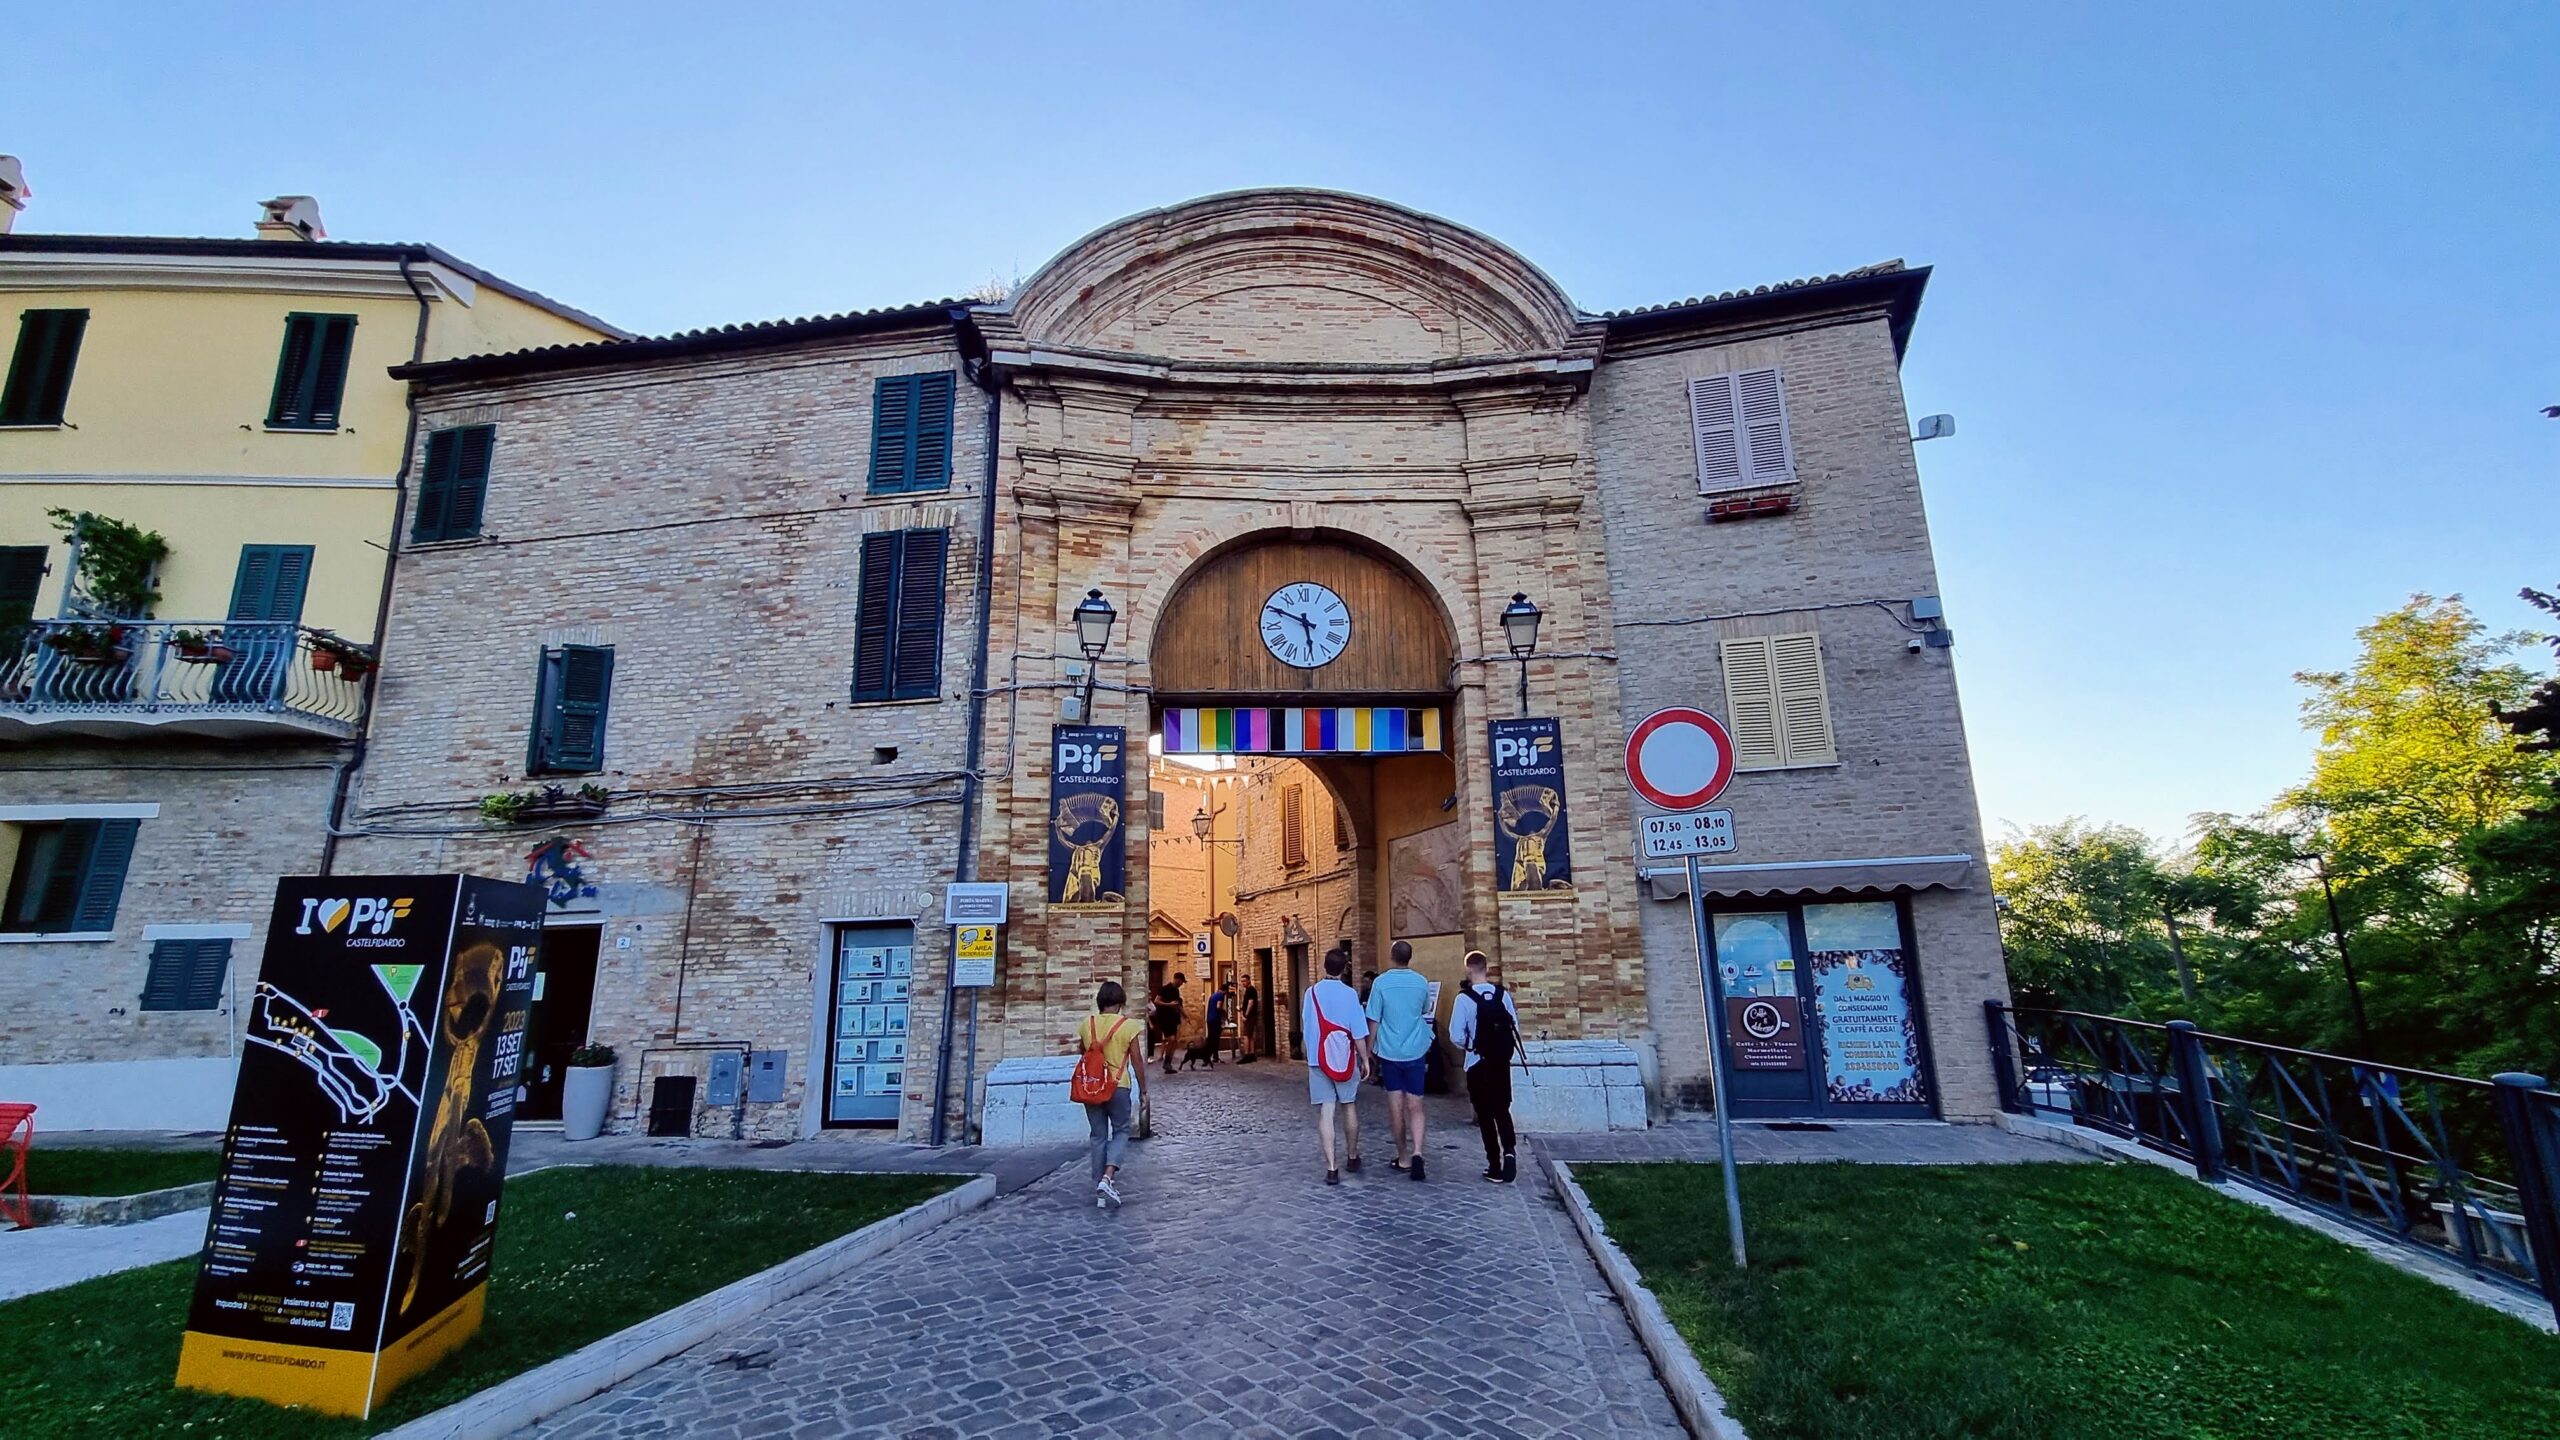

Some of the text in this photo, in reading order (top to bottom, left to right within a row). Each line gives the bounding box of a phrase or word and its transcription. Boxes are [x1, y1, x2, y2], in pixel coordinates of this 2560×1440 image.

[1297, 588, 1309, 602] XII
[1320, 643, 1331, 657] V
[1497, 767, 1556, 777] CASTELFIDARDO
[1058, 775, 1119, 784] CASTELFIDARDO
[296, 898, 318, 934] I
[346, 939, 405, 947] CASTELFIDARDO
[502, 1010, 526, 1032] 2023
[1832, 1015, 1899, 1023] GRATUITAMENTE
[1845, 1025, 1867, 1033] CAFFÈ
[496, 1032, 523, 1056] 13 SET
[492, 1054, 520, 1079] 17 SET
[283, 1297, 309, 1308] insieme
[302, 1318, 326, 1328] festival
